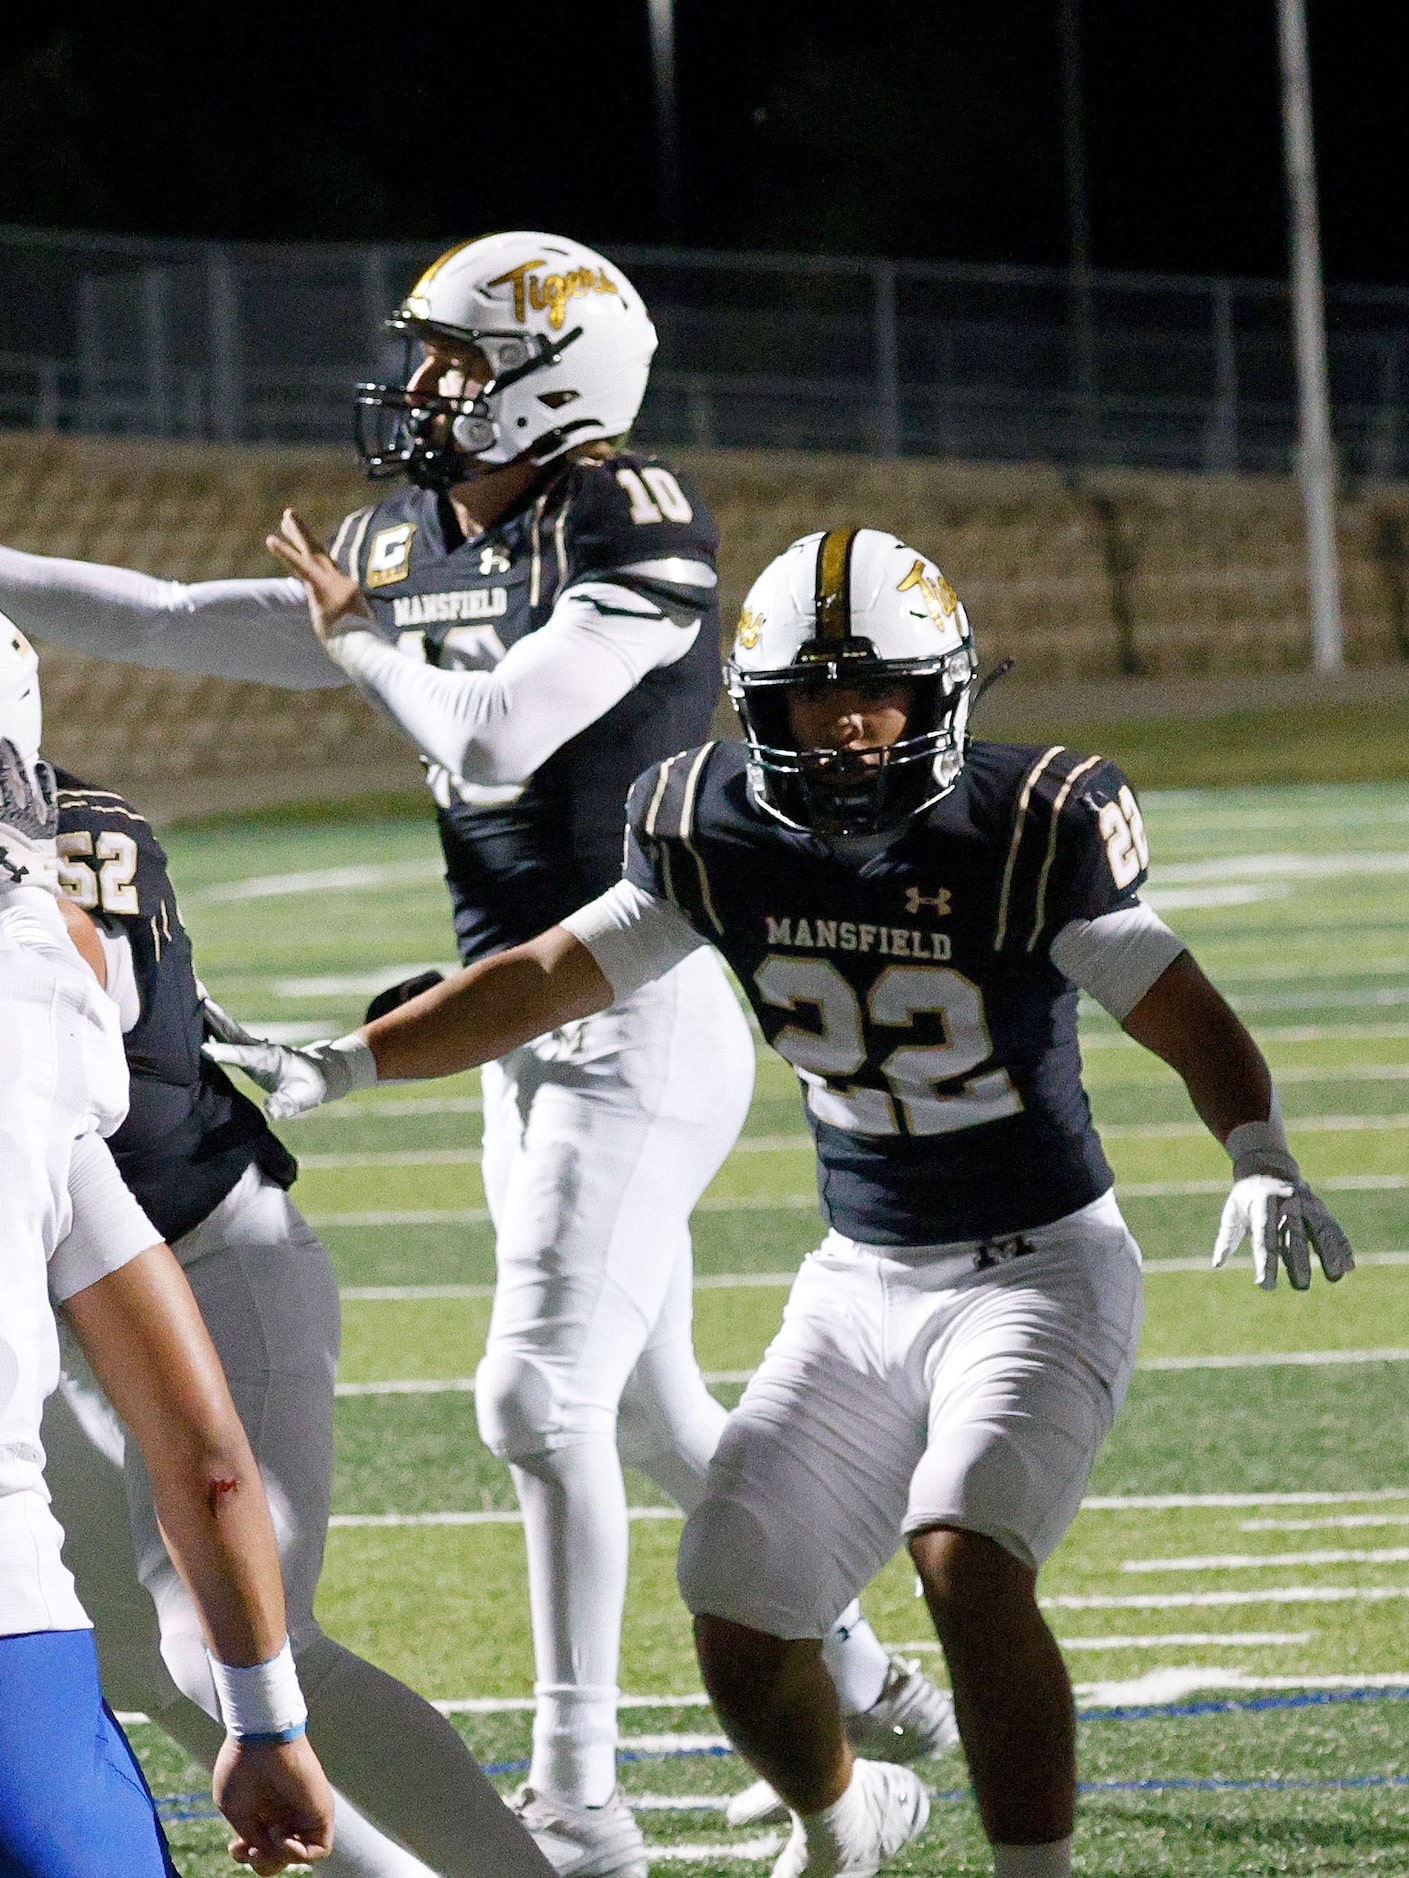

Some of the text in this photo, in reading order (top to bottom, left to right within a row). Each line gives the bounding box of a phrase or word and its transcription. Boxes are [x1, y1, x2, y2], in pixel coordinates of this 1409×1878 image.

[616, 466, 694, 525] 10
[371, 525, 411, 571] C
[393, 586, 509, 628] MANSFIELD
[55, 830, 141, 915] 52
[765, 915, 953, 961] MANSFIELD
[752, 952, 1026, 1137] 22
